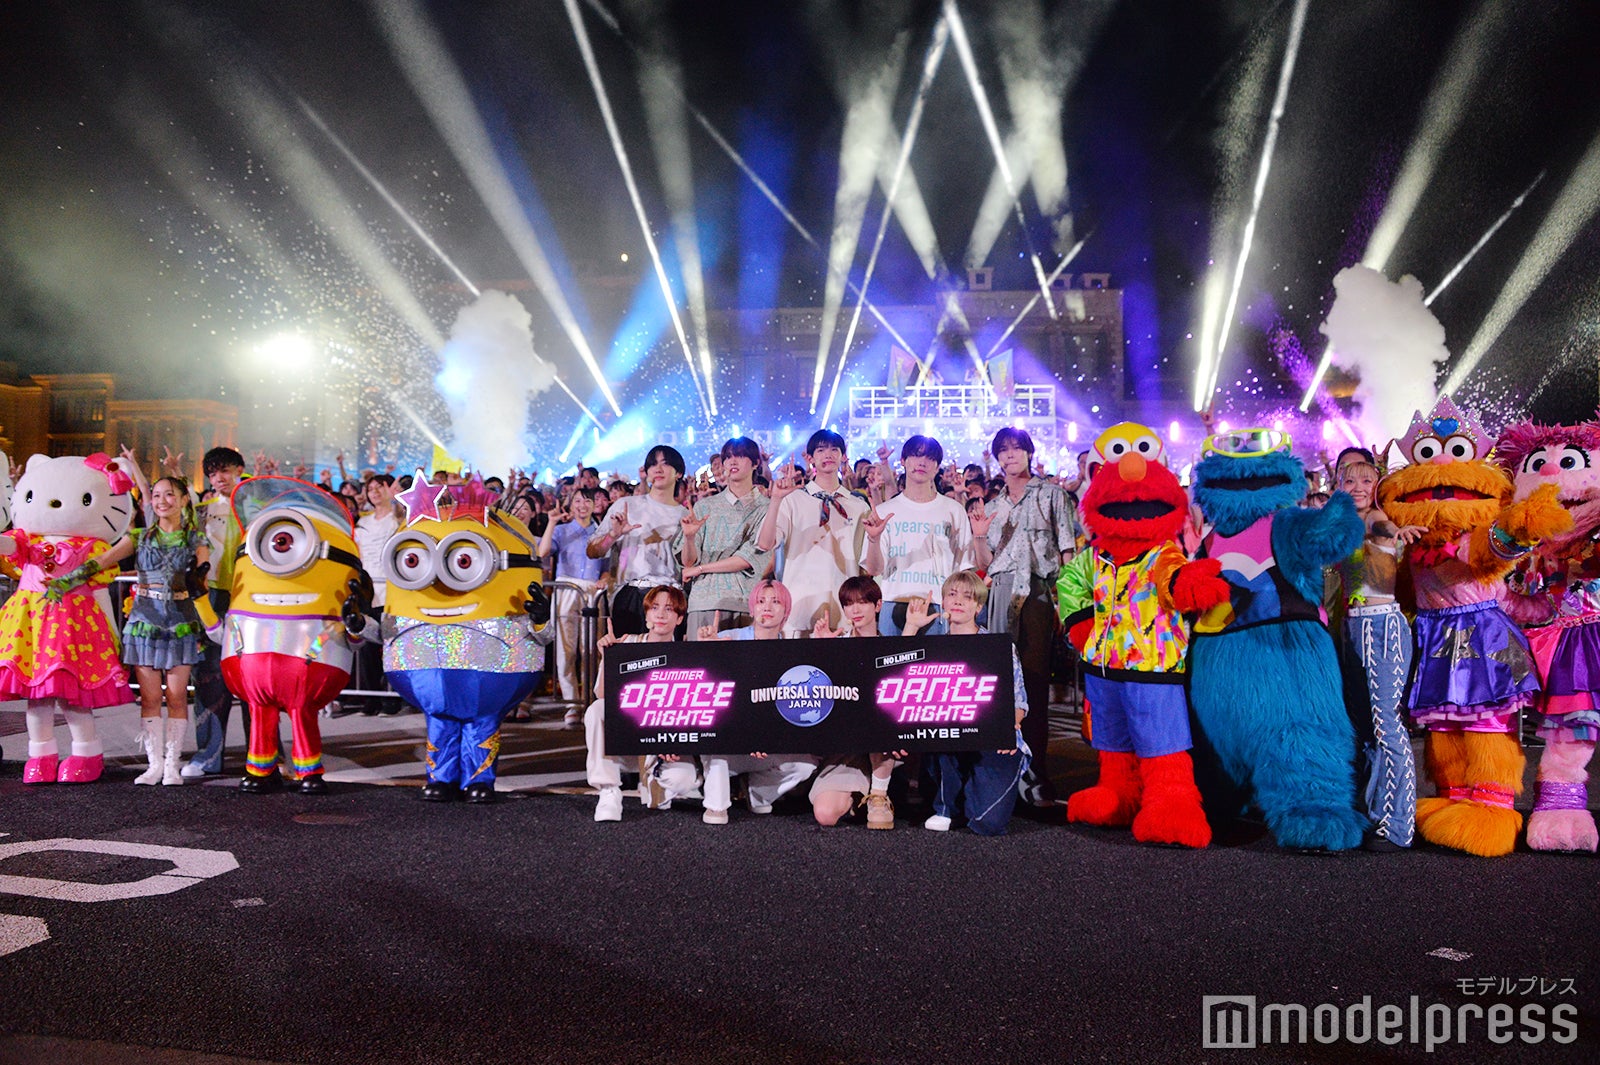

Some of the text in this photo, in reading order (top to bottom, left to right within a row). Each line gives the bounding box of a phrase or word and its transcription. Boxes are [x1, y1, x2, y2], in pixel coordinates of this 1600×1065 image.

[895, 521, 930, 536] years
[627, 658, 660, 671] NO LIMIT!
[883, 652, 917, 665] NO LIMIT!
[650, 670, 705, 681] SUMMER
[908, 664, 965, 675] SUMMER
[620, 682, 735, 708] DANCE
[751, 685, 860, 703] UNIVERSAL STUDIOS
[877, 676, 998, 704] DANCE
[788, 700, 821, 709] JAPAN
[640, 709, 715, 726] NIGHTS
[898, 704, 977, 722] NIGHTS
[657, 732, 699, 743] HYBE
[916, 728, 960, 739] HYBE
